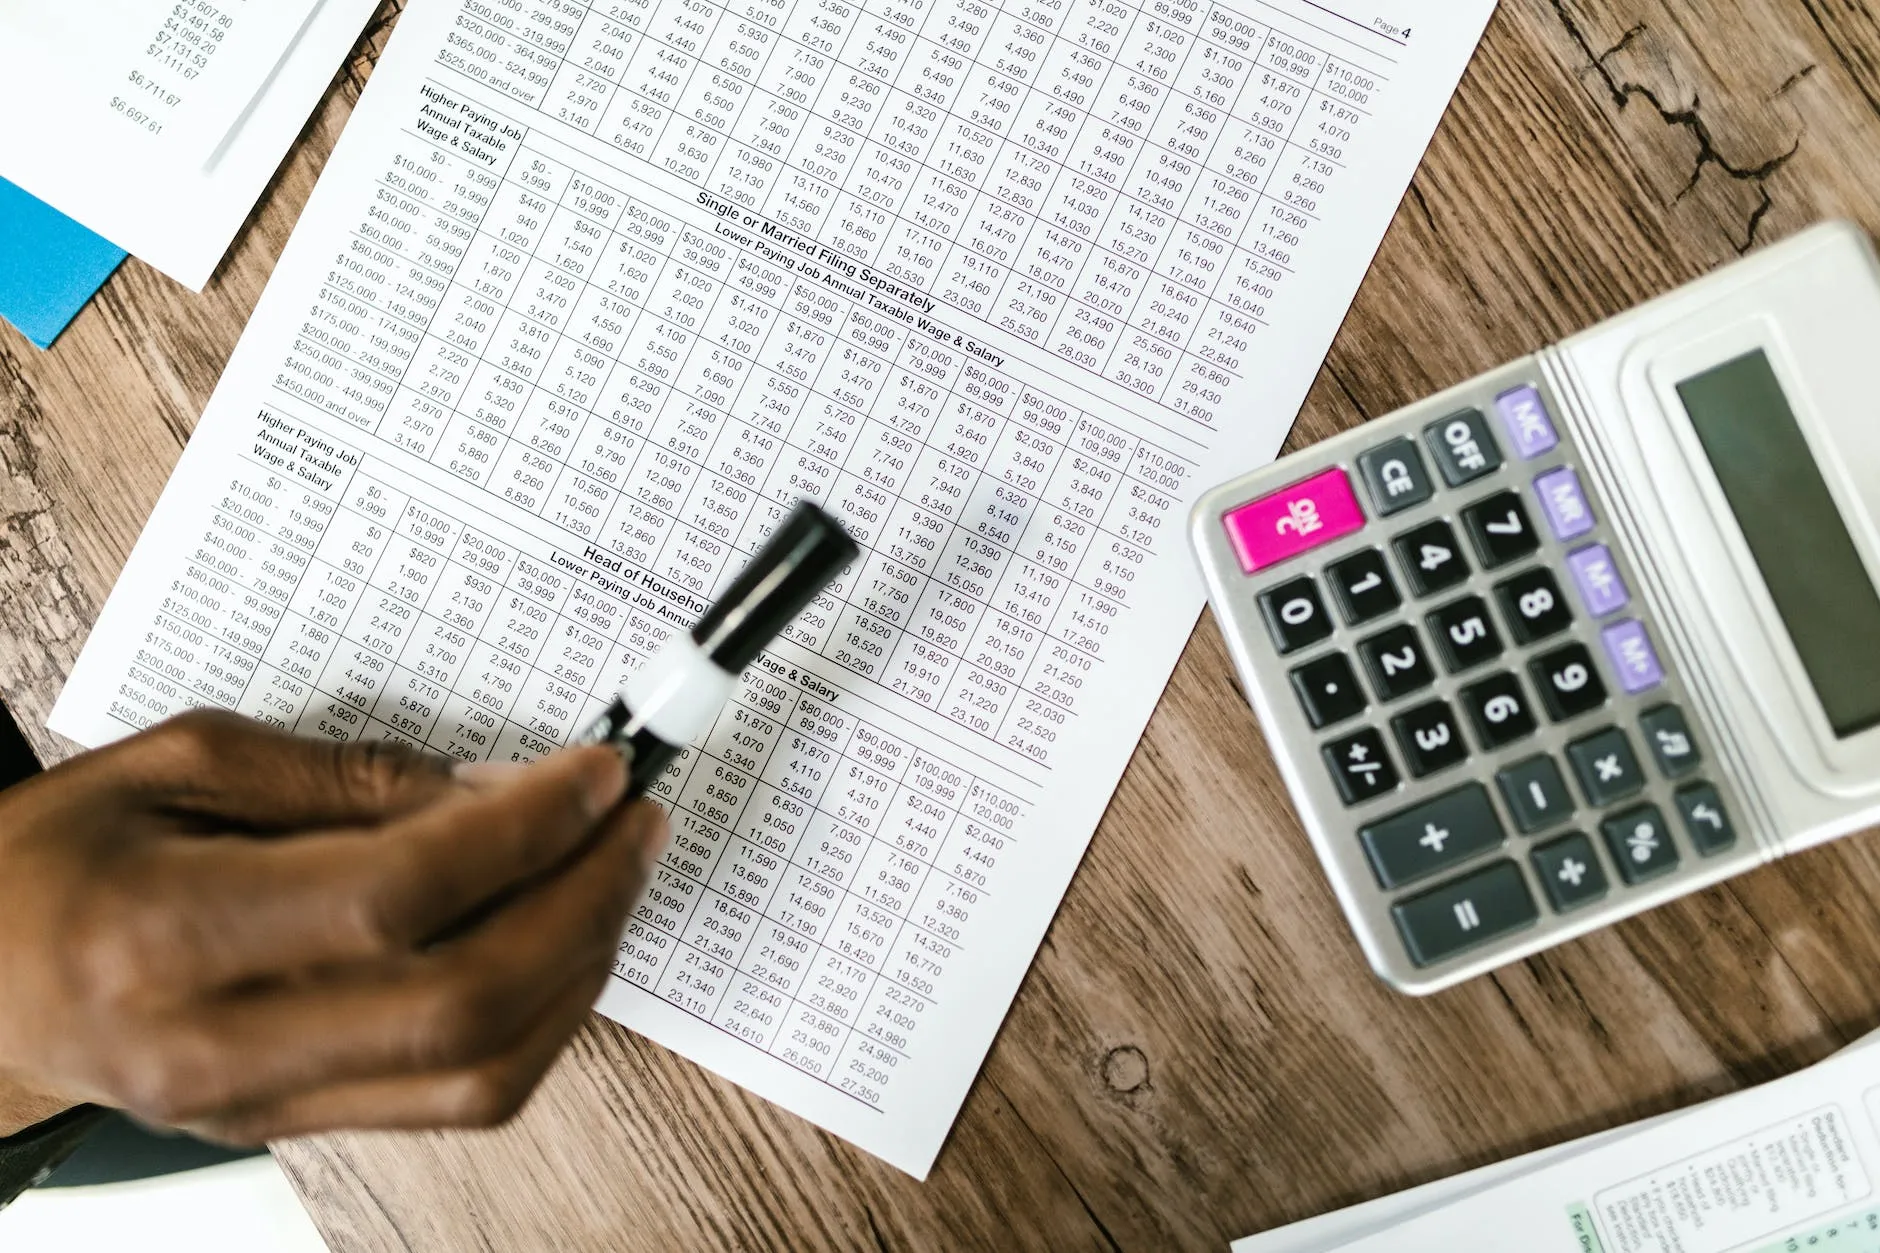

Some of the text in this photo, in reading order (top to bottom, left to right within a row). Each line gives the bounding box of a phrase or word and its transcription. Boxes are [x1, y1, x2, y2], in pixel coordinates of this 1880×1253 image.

[1373, 16, 1411, 39] Page 4
[1146, 20, 1359, 124] $1,020 $1,100 $1,870 $1,870
[420, 84, 521, 140] Higher Paying Job
[420, 104, 506, 151] Annual Taxable
[417, 118, 497, 166] Wage & Salary
[1023, 133, 1290, 264] 10,340 11,340 12,340 13,260 13,460
[438, 48, 1213, 422] $525,000 and over 3,140 6,840 10,200 12,900 15,530 18,030 20,530 23,030 25,530 28,030 30,300 31,800
[696, 191, 936, 318] Single or Married Filing Separately
[714, 222, 1005, 373] Lower Paying Job Annual Taxable Wage & Salary
[518, 193, 1170, 510] $440 $940 $1,020 $1,020 $1,410 $1,870 $1,870 $1,870 $1,870 $2,030 $2,040 $2,040
[257, 409, 357, 466] Higher Paying Job
[1445, 421, 1486, 470] OFF
[1512, 401, 1547, 443] MC
[253, 443, 333, 491] Wage & Salary
[257, 429, 342, 477] Annual Taxable
[1382, 460, 1413, 496] CE
[1486, 510, 1522, 534] 7
[1552, 484, 1584, 523] MR
[275, 373, 1048, 760] $450,000 and over 3,140 6,250 8,830 11,330 13,830 15,790 20,290 21,790 23,100 24,400
[583, 545, 710, 616] Head of Househol
[1420, 544, 1452, 570] 4
[1350, 572, 1381, 594] 1
[1520, 588, 1554, 618] 8
[550, 551, 589, 576] Lower
[589, 570, 631, 600] Paying
[632, 593, 655, 610] Job
[656, 605, 697, 631] Annua
[788, 669, 798, 682] &
[799, 674, 839, 702] Salary
[1281, 598, 1314, 624] 0
[1450, 617, 1486, 644] 5
[1381, 646, 1416, 676] 2
[1552, 663, 1588, 691] 9
[366, 526, 1004, 850] $0 $820 $930 $1,020 $1,020 $1,870 $1,870 $1,910 $2,040 $2,040
[1484, 695, 1520, 723] 6
[1415, 723, 1450, 750] 3
[1626, 822, 1659, 862] %
[667, 988, 706, 1014] 23,110
[724, 1017, 764, 1044] 24,610
[782, 1047, 822, 1074] 26,050
[840, 1077, 880, 1103] 27,350
